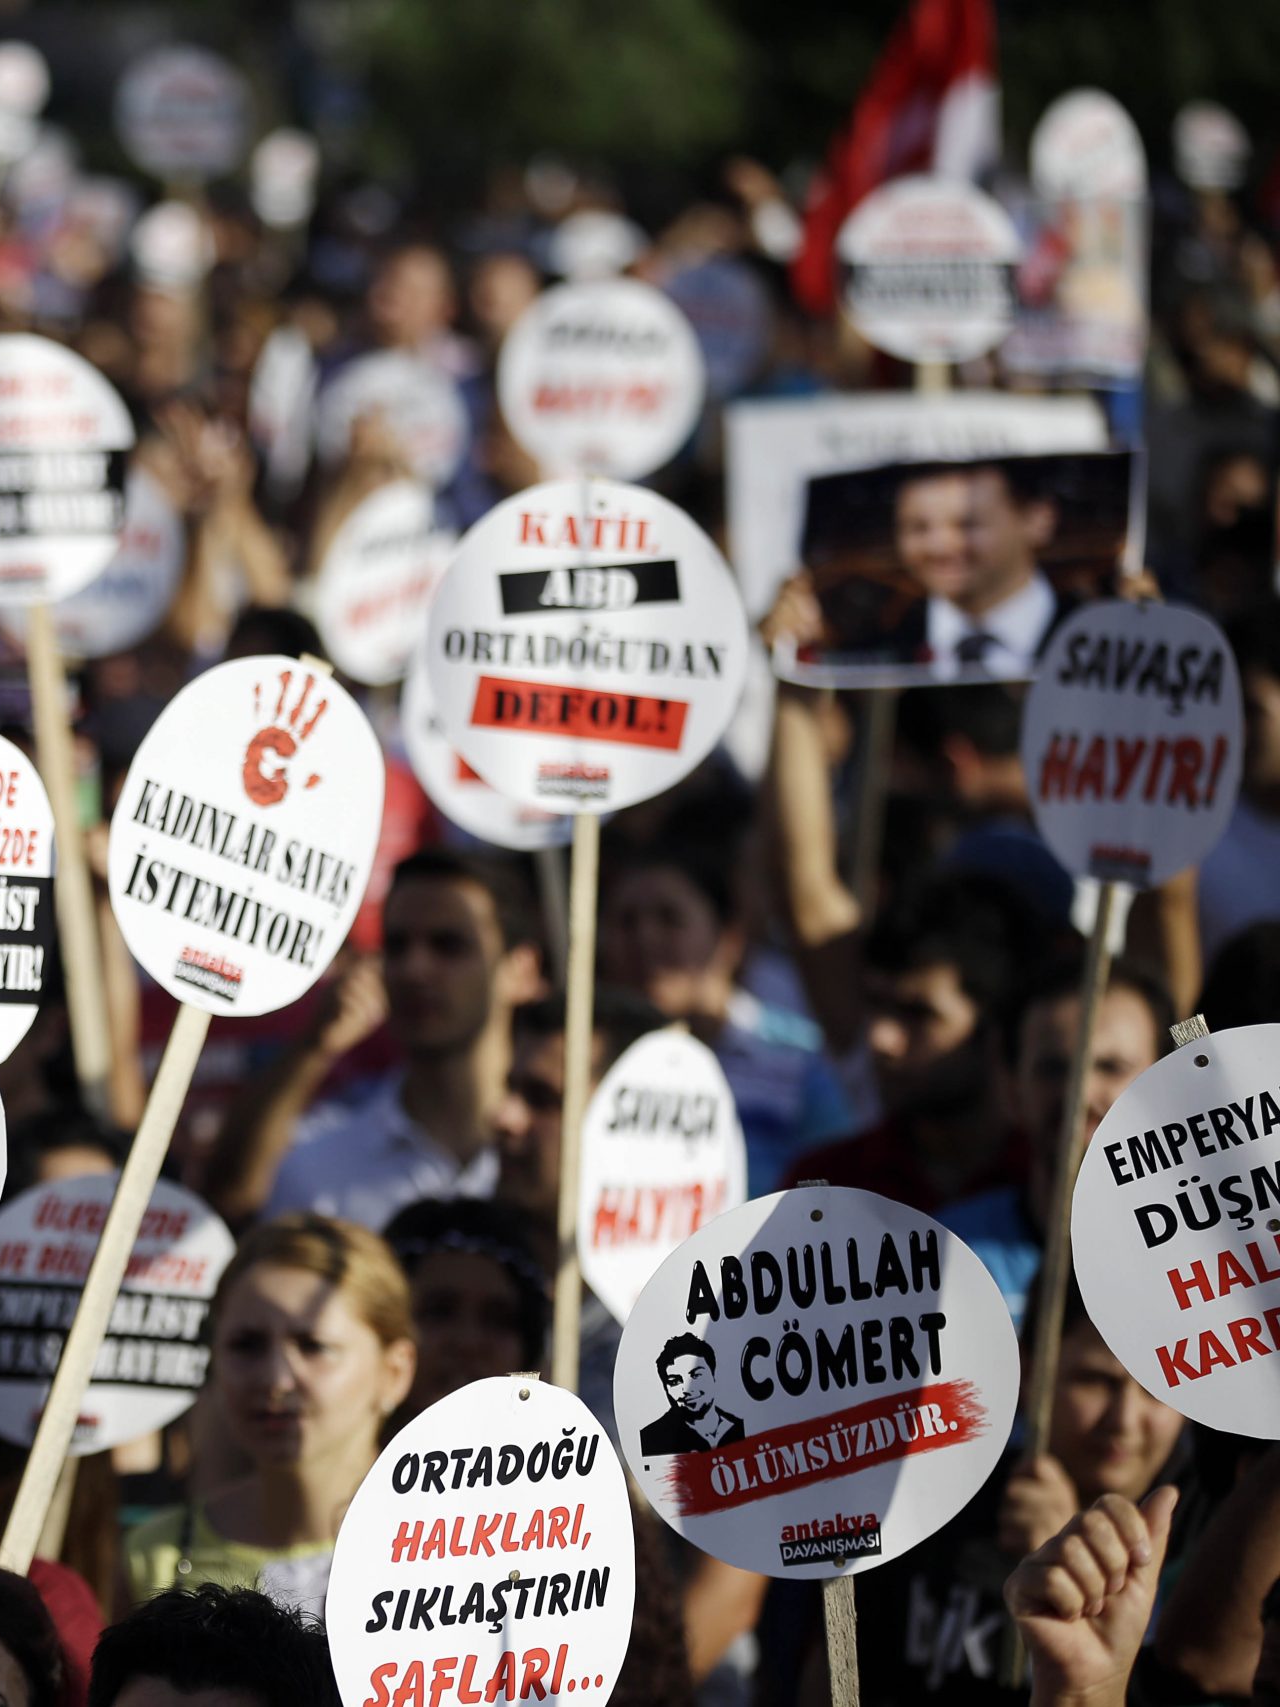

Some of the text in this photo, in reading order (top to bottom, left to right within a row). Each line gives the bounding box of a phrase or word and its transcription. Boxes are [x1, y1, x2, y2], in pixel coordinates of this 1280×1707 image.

[519, 512, 661, 555] KATİL
[539, 568, 640, 610] ABD
[1058, 632, 1225, 716] SAVAŞA
[493, 688, 670, 733] DEFOL!
[1040, 730, 1228, 812] HAYIR!
[131, 778, 278, 876] KADINLAR
[123, 842, 325, 972] İSTEMİYOR!
[1103, 1086, 1280, 1187] EMPERYA
[686, 1229, 941, 1325] ABDULLAH
[740, 1312, 947, 1401] CÖMERT
[391, 1426, 600, 1495] ORTADOĞU
[710, 1401, 959, 1498] ÖLÜMSÜZDÜR.
[390, 1503, 592, 1563] HALKLARI,
[781, 1512, 877, 1542] antakya
[782, 1532, 880, 1560] DAYANIŞMASI
[365, 1566, 611, 1634] SIKLAŞTIRIN
[362, 1643, 604, 1707] SAFLARI...
